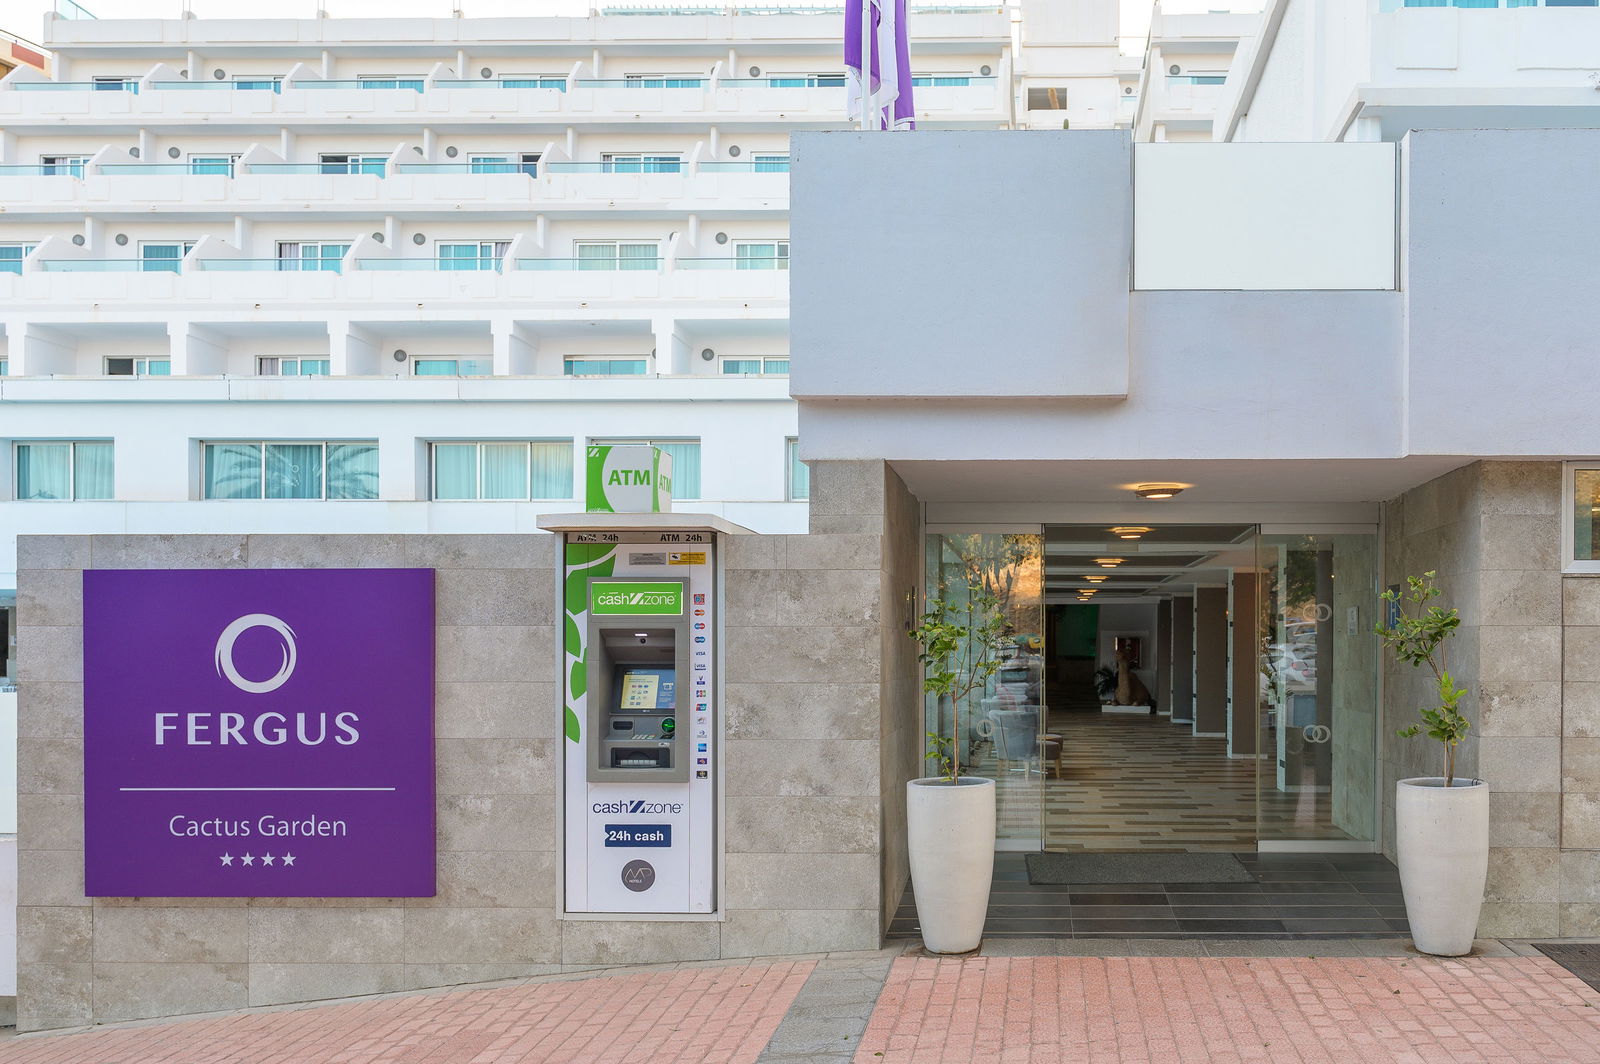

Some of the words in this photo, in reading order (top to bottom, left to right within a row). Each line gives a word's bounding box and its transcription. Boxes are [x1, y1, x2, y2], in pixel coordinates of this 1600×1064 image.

[608, 469, 651, 486] ATM
[659, 474, 672, 494] ATM
[577, 534, 597, 542] ATM
[602, 534, 619, 542] 24h
[660, 534, 680, 542] ATM
[685, 534, 703, 542] 24h
[154, 711, 361, 746] FERGUS
[168, 814, 251, 837] Cactus
[257, 814, 347, 837] Garden
[609, 830, 631, 841] 24h
[634, 830, 664, 841] cash
